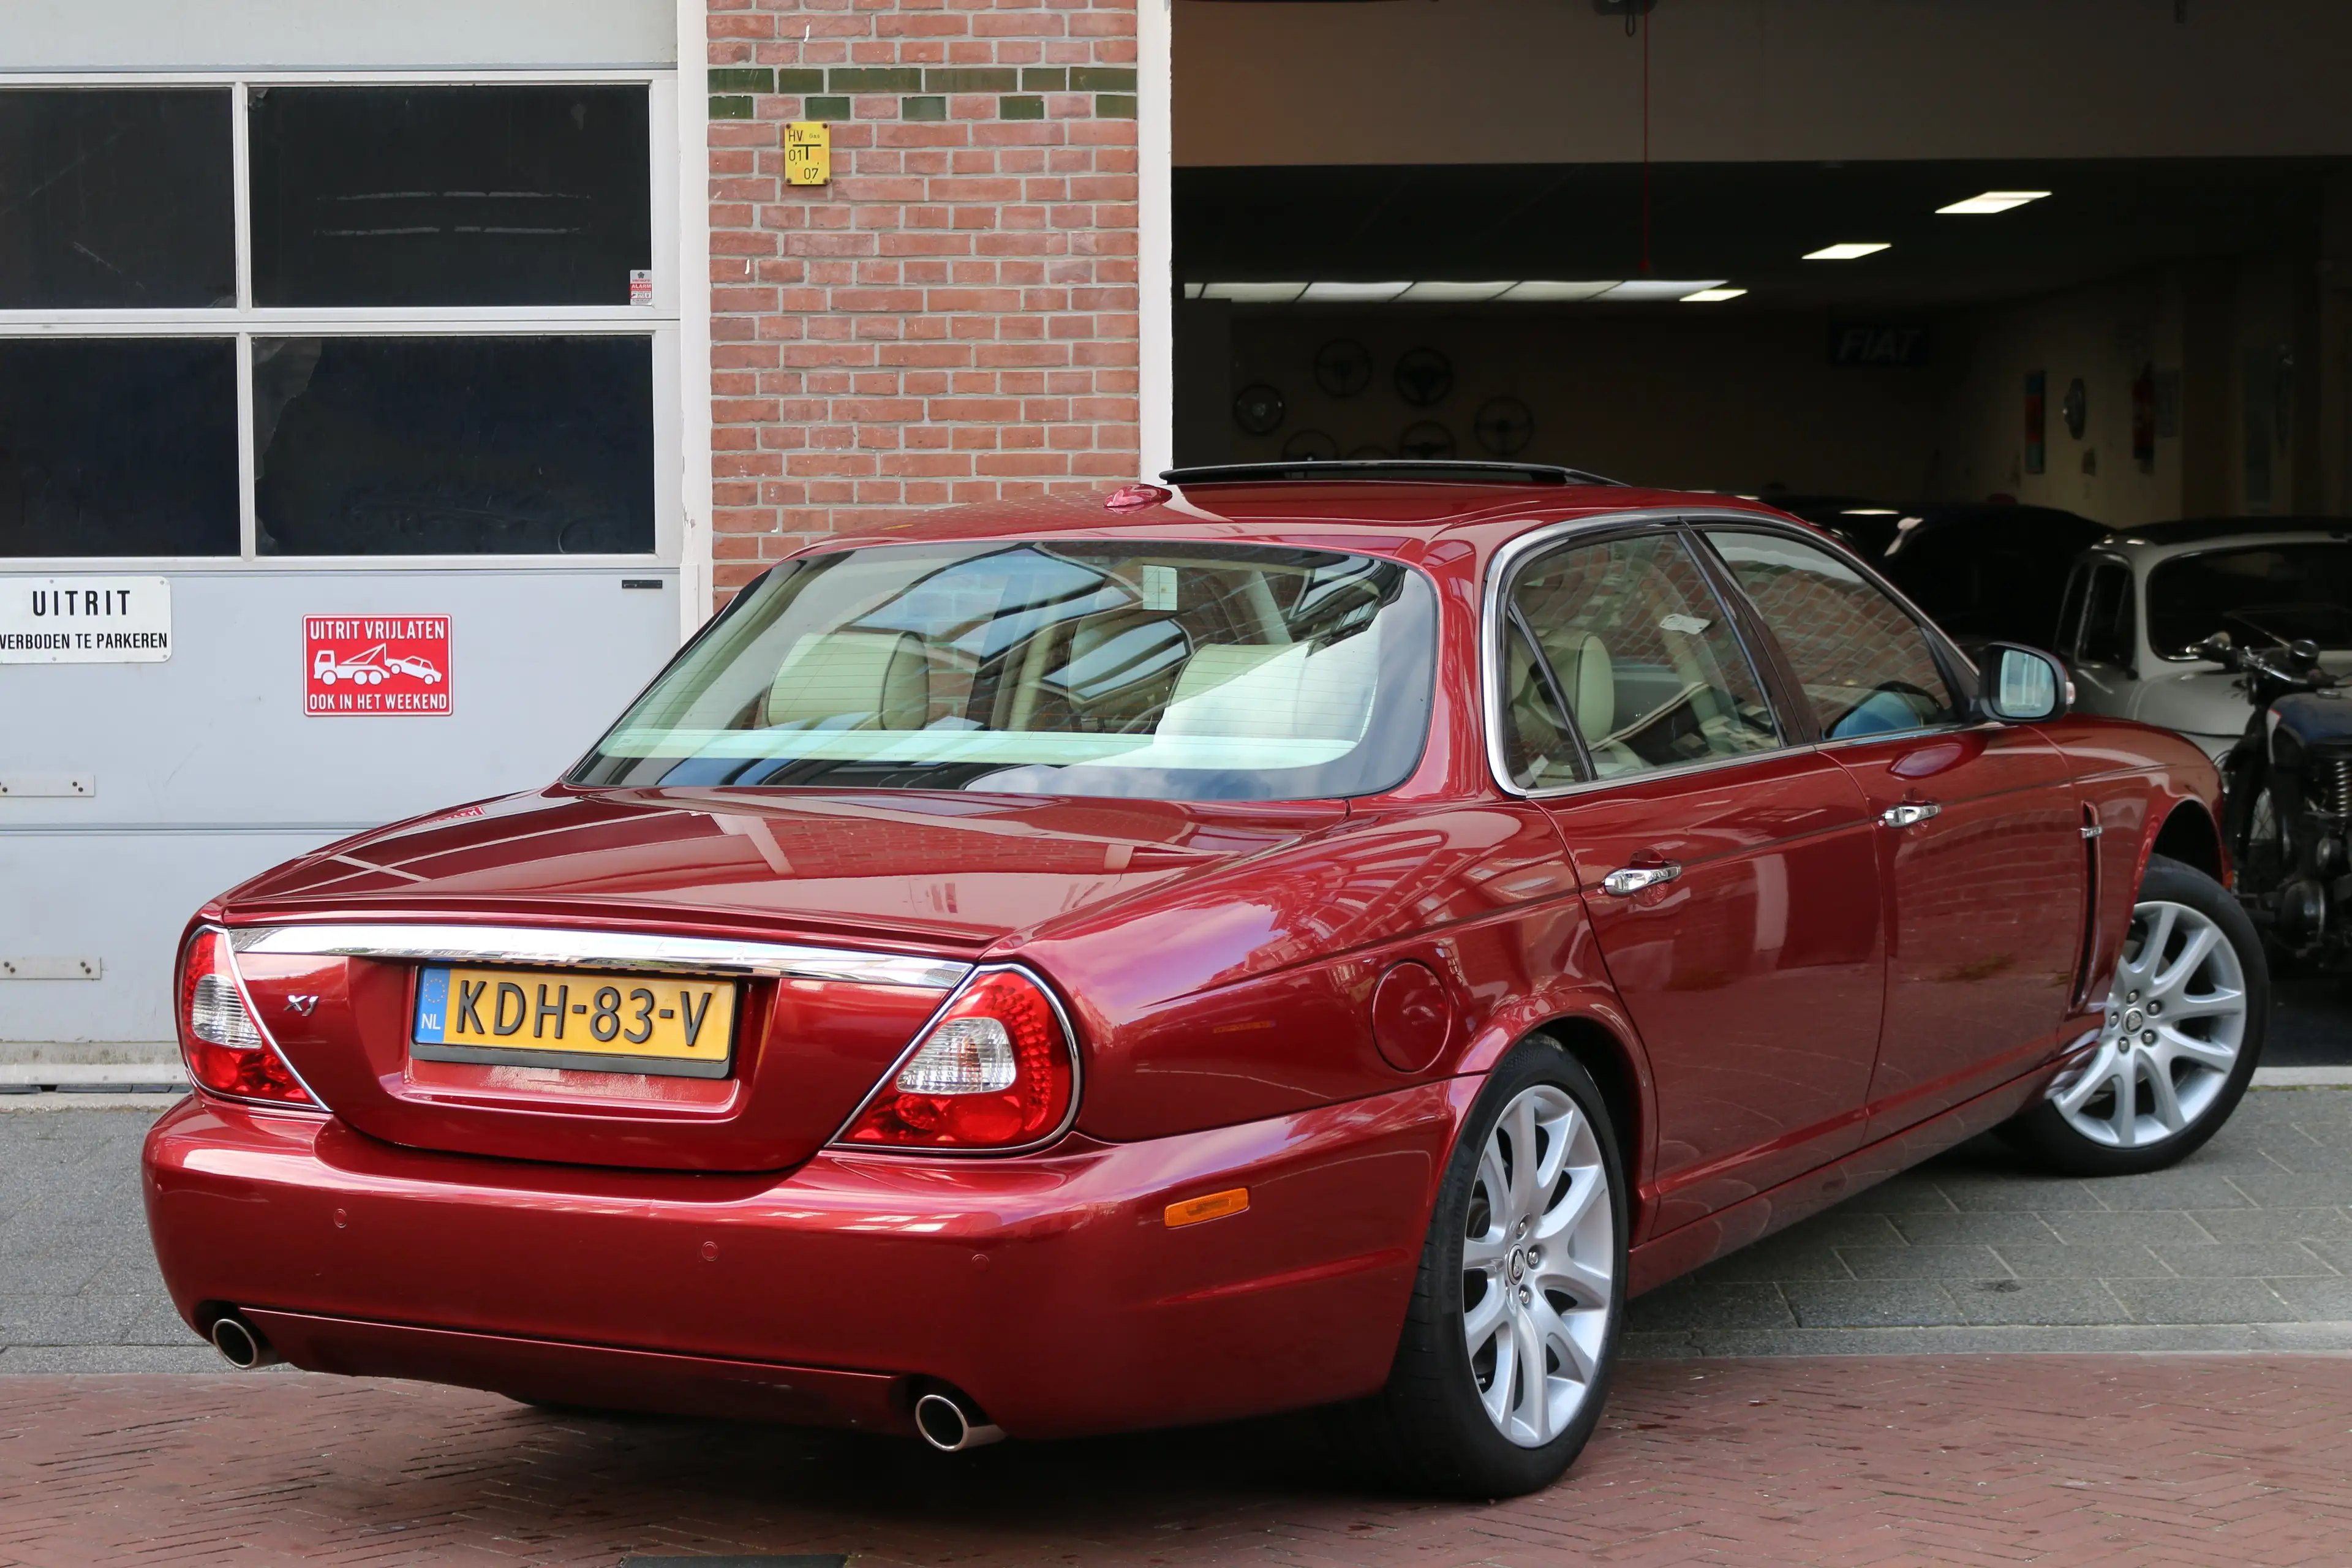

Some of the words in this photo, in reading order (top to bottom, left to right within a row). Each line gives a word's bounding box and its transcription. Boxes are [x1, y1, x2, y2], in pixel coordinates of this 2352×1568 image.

[789, 130, 803, 141] HV
[1838, 328, 1922, 361] FIAT
[32, 590, 131, 616] UITRIT
[310, 620, 360, 640] UITRIT
[365, 620, 445, 639] VRIJLATEN
[0, 633, 70, 649] VERBODEN
[75, 633, 92, 649] TE
[97, 633, 167, 648] PARKEREN
[309, 694, 335, 710] OOK
[340, 694, 352, 709] IN
[357, 694, 381, 709] HET
[385, 694, 447, 709] WEEKEND
[421, 1013, 441, 1030] NL
[456, 980, 712, 1047] KDH-83-V
